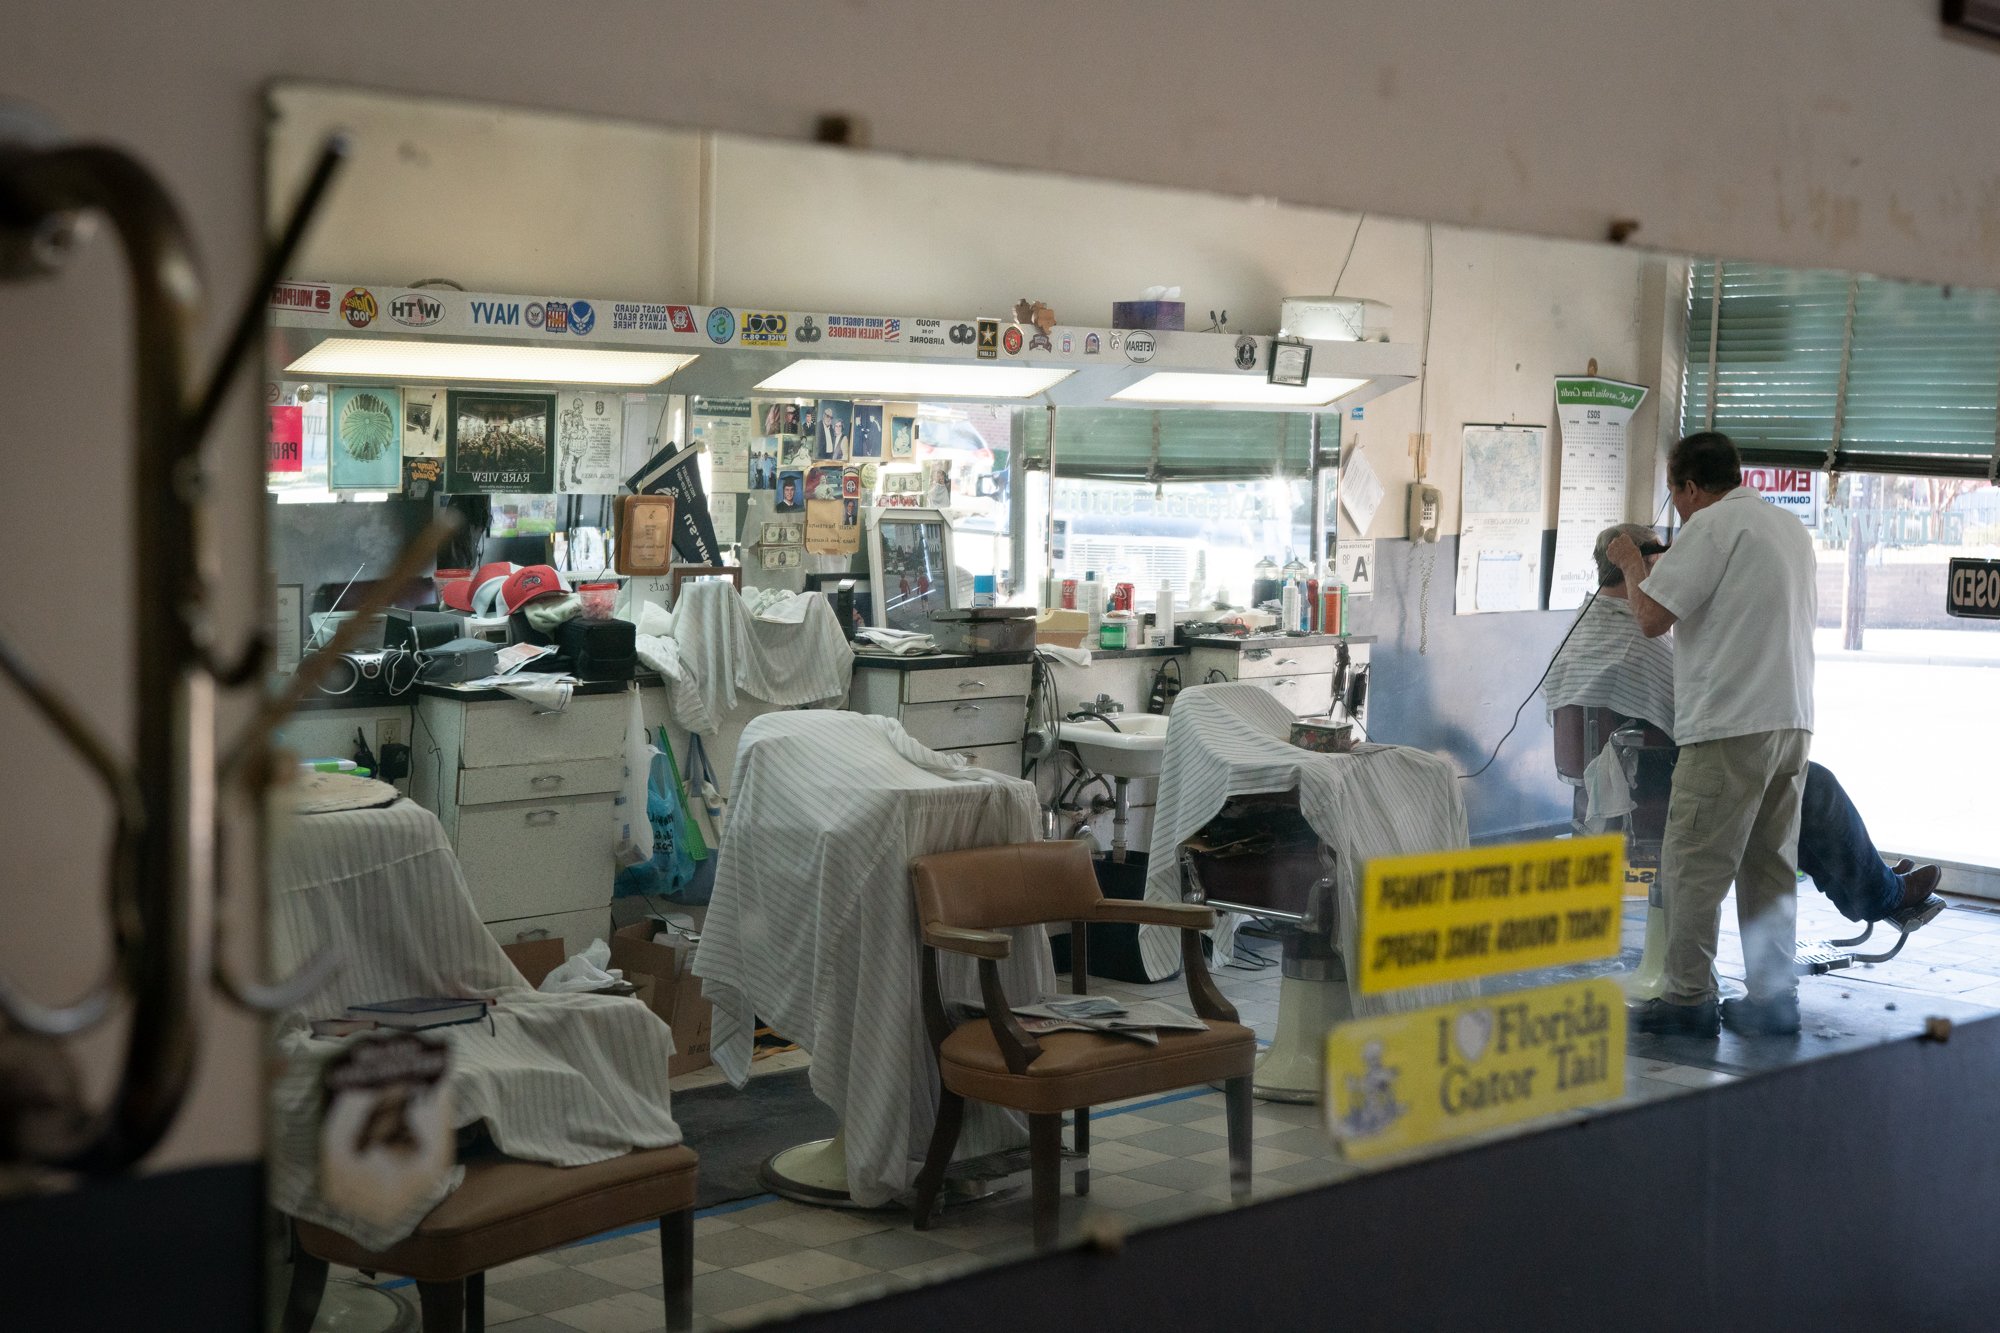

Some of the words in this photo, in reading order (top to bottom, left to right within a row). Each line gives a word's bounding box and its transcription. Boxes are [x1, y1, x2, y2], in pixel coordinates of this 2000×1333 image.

[1815, 507, 1964, 546] NVILLE
[1495, 988, 1610, 1054] Florida
[1438, 1064, 1536, 1116] Gator
[1550, 1036, 1608, 1091] Tail
